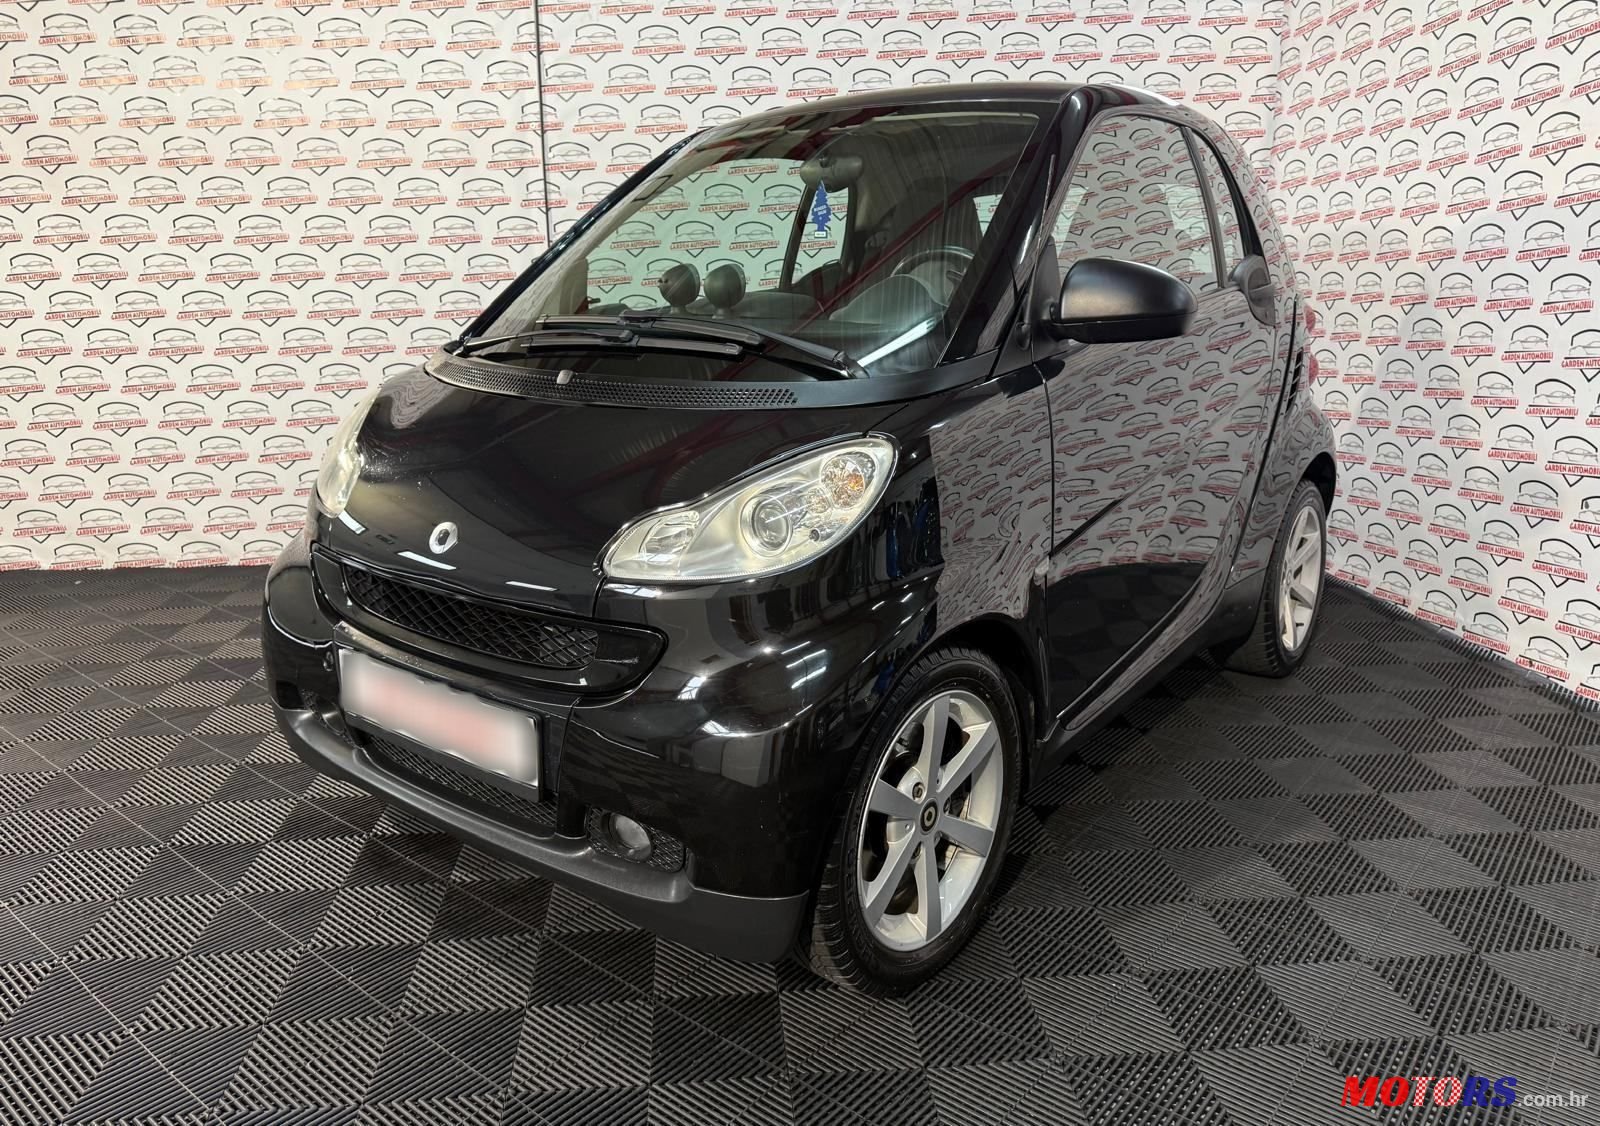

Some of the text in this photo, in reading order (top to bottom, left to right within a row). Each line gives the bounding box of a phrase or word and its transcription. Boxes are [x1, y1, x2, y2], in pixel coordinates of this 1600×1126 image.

[1506, 36, 1537, 56] AUTOMOBILI
[1531, 84, 1564, 102] AUTOMOBILI
[1475, 97, 1504, 113] AUTOMOBILI
[1551, 134, 1586, 151] AUTOMOBILI
[1493, 144, 1522, 159] AUTOMOBILI
[1462, 198, 1490, 210] AUTOMOBILI
[1516, 193, 1547, 207] AUTOMOBILI
[1480, 247, 1508, 258] AUTOMOBILI
[1536, 246, 1570, 258] AUTOMOBILI
[1503, 298, 1533, 308] AUTOMOBILI
[1560, 300, 1594, 311] AUTOMOBILI
[1507, 452, 1537, 461] AUTOMOBILI
[1475, 492, 1504, 502] AUTOMOBILI
[1530, 508, 1563, 519] AUTOMOBILI
[1495, 547, 1524, 558] AUTOMOBILI
[1554, 567, 1588, 580] AUTOMOBILI
[1465, 582, 1492, 595] AUTOMOBILI
[1517, 604, 1548, 618] AUTOMOBILI
[1481, 636, 1510, 652] AUTOMOBILI
[1536, 665, 1570, 680] AUTOMOBILI
